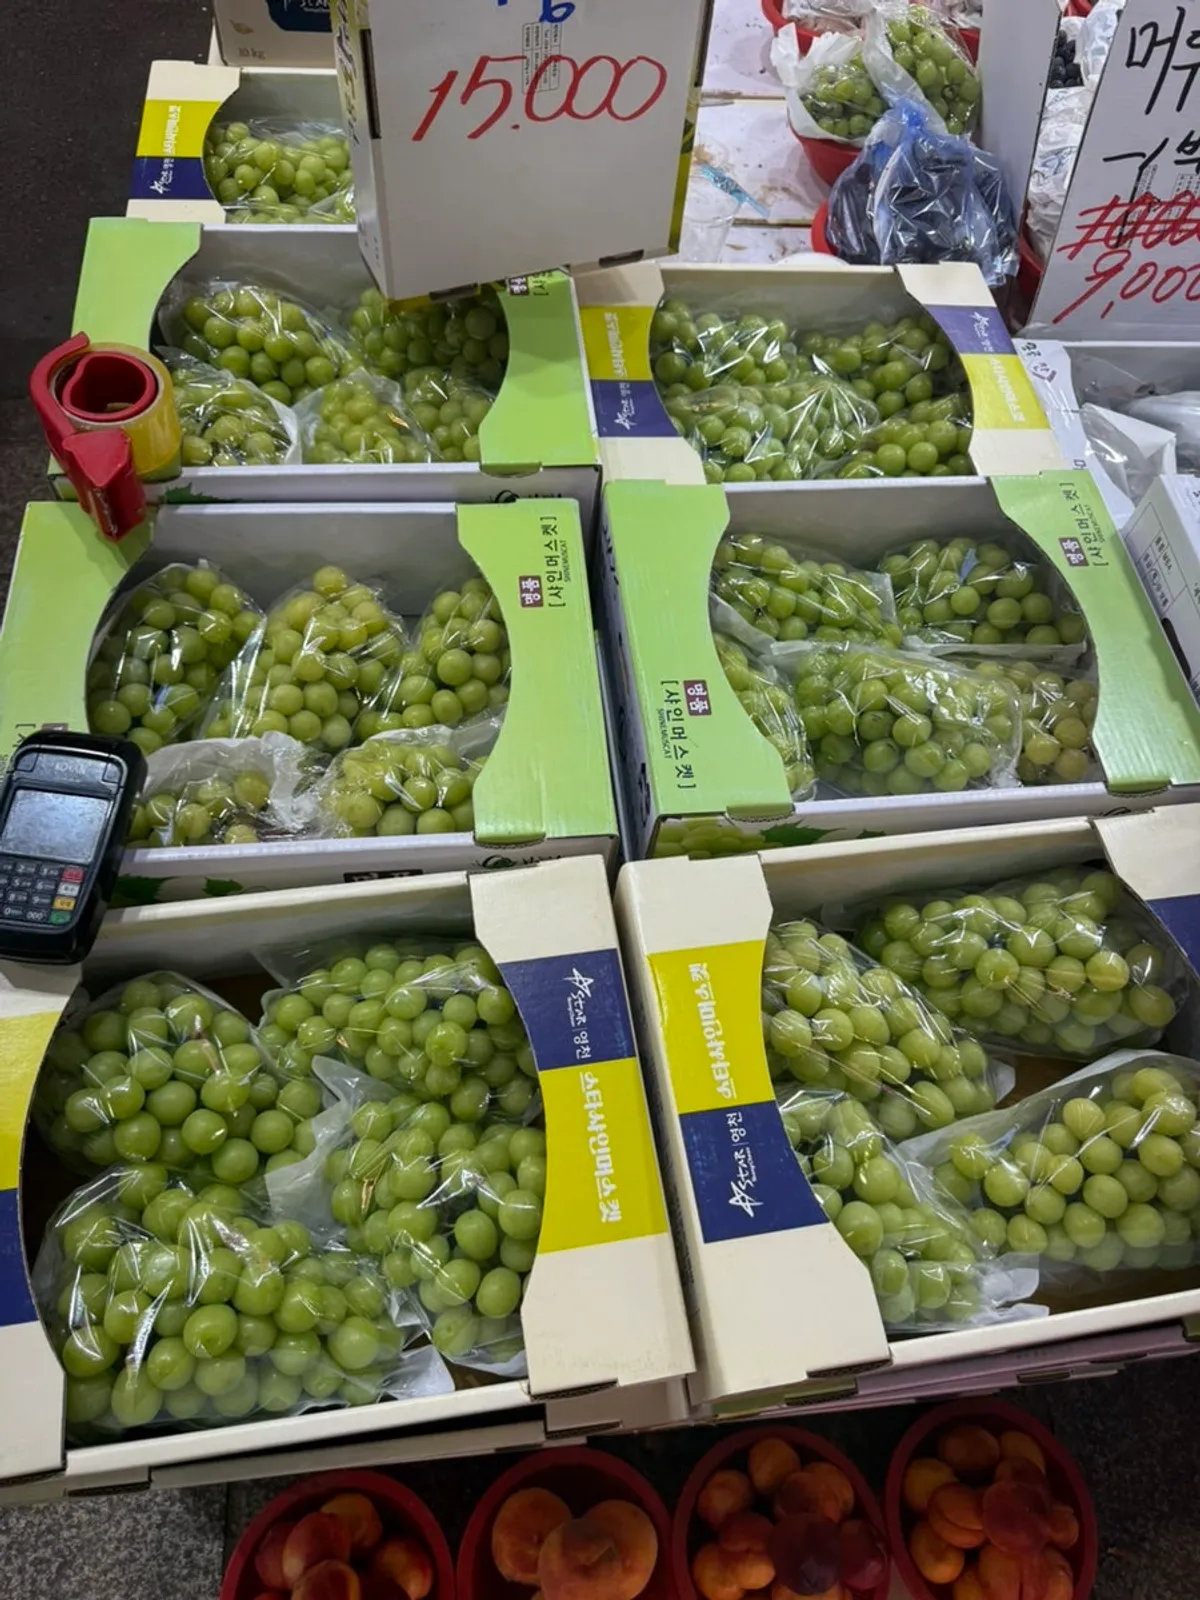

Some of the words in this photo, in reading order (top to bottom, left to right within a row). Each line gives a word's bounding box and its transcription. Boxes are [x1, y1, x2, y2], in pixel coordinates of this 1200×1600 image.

[687, 683, 709, 714] 명품
[573, 1031, 592, 1059] 영천
[726, 1112, 746, 1142] 영천
